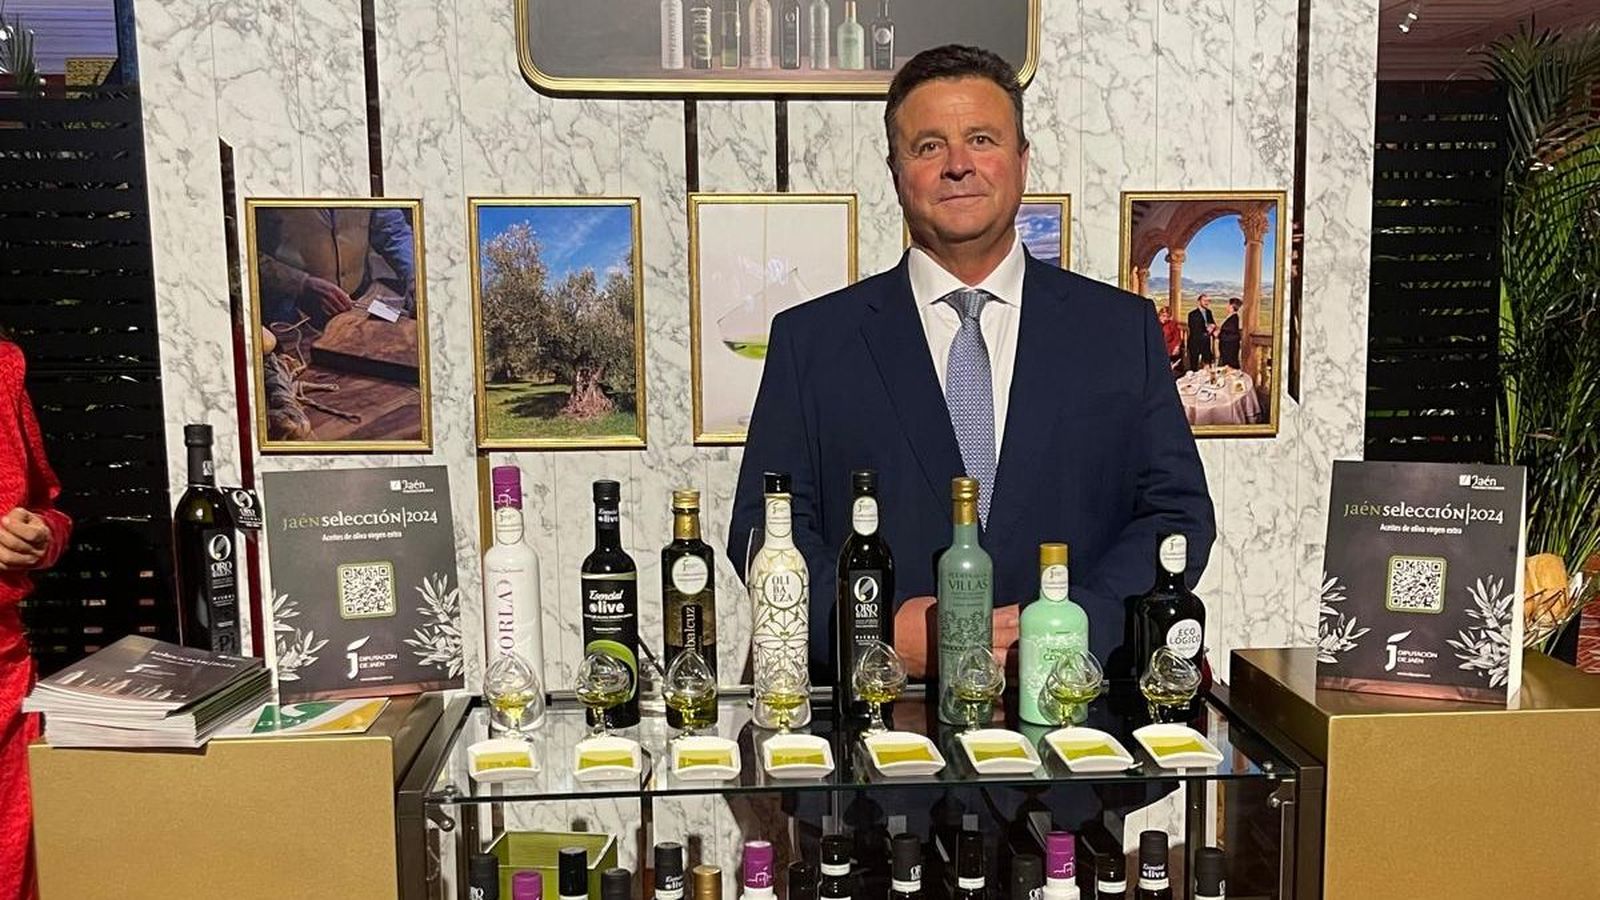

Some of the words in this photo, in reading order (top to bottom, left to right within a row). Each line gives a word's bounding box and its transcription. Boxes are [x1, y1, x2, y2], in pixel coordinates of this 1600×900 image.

[948, 579, 989, 591] VILLAS
[589, 600, 625, 613] olive
[1178, 627, 1196, 637] ECO
